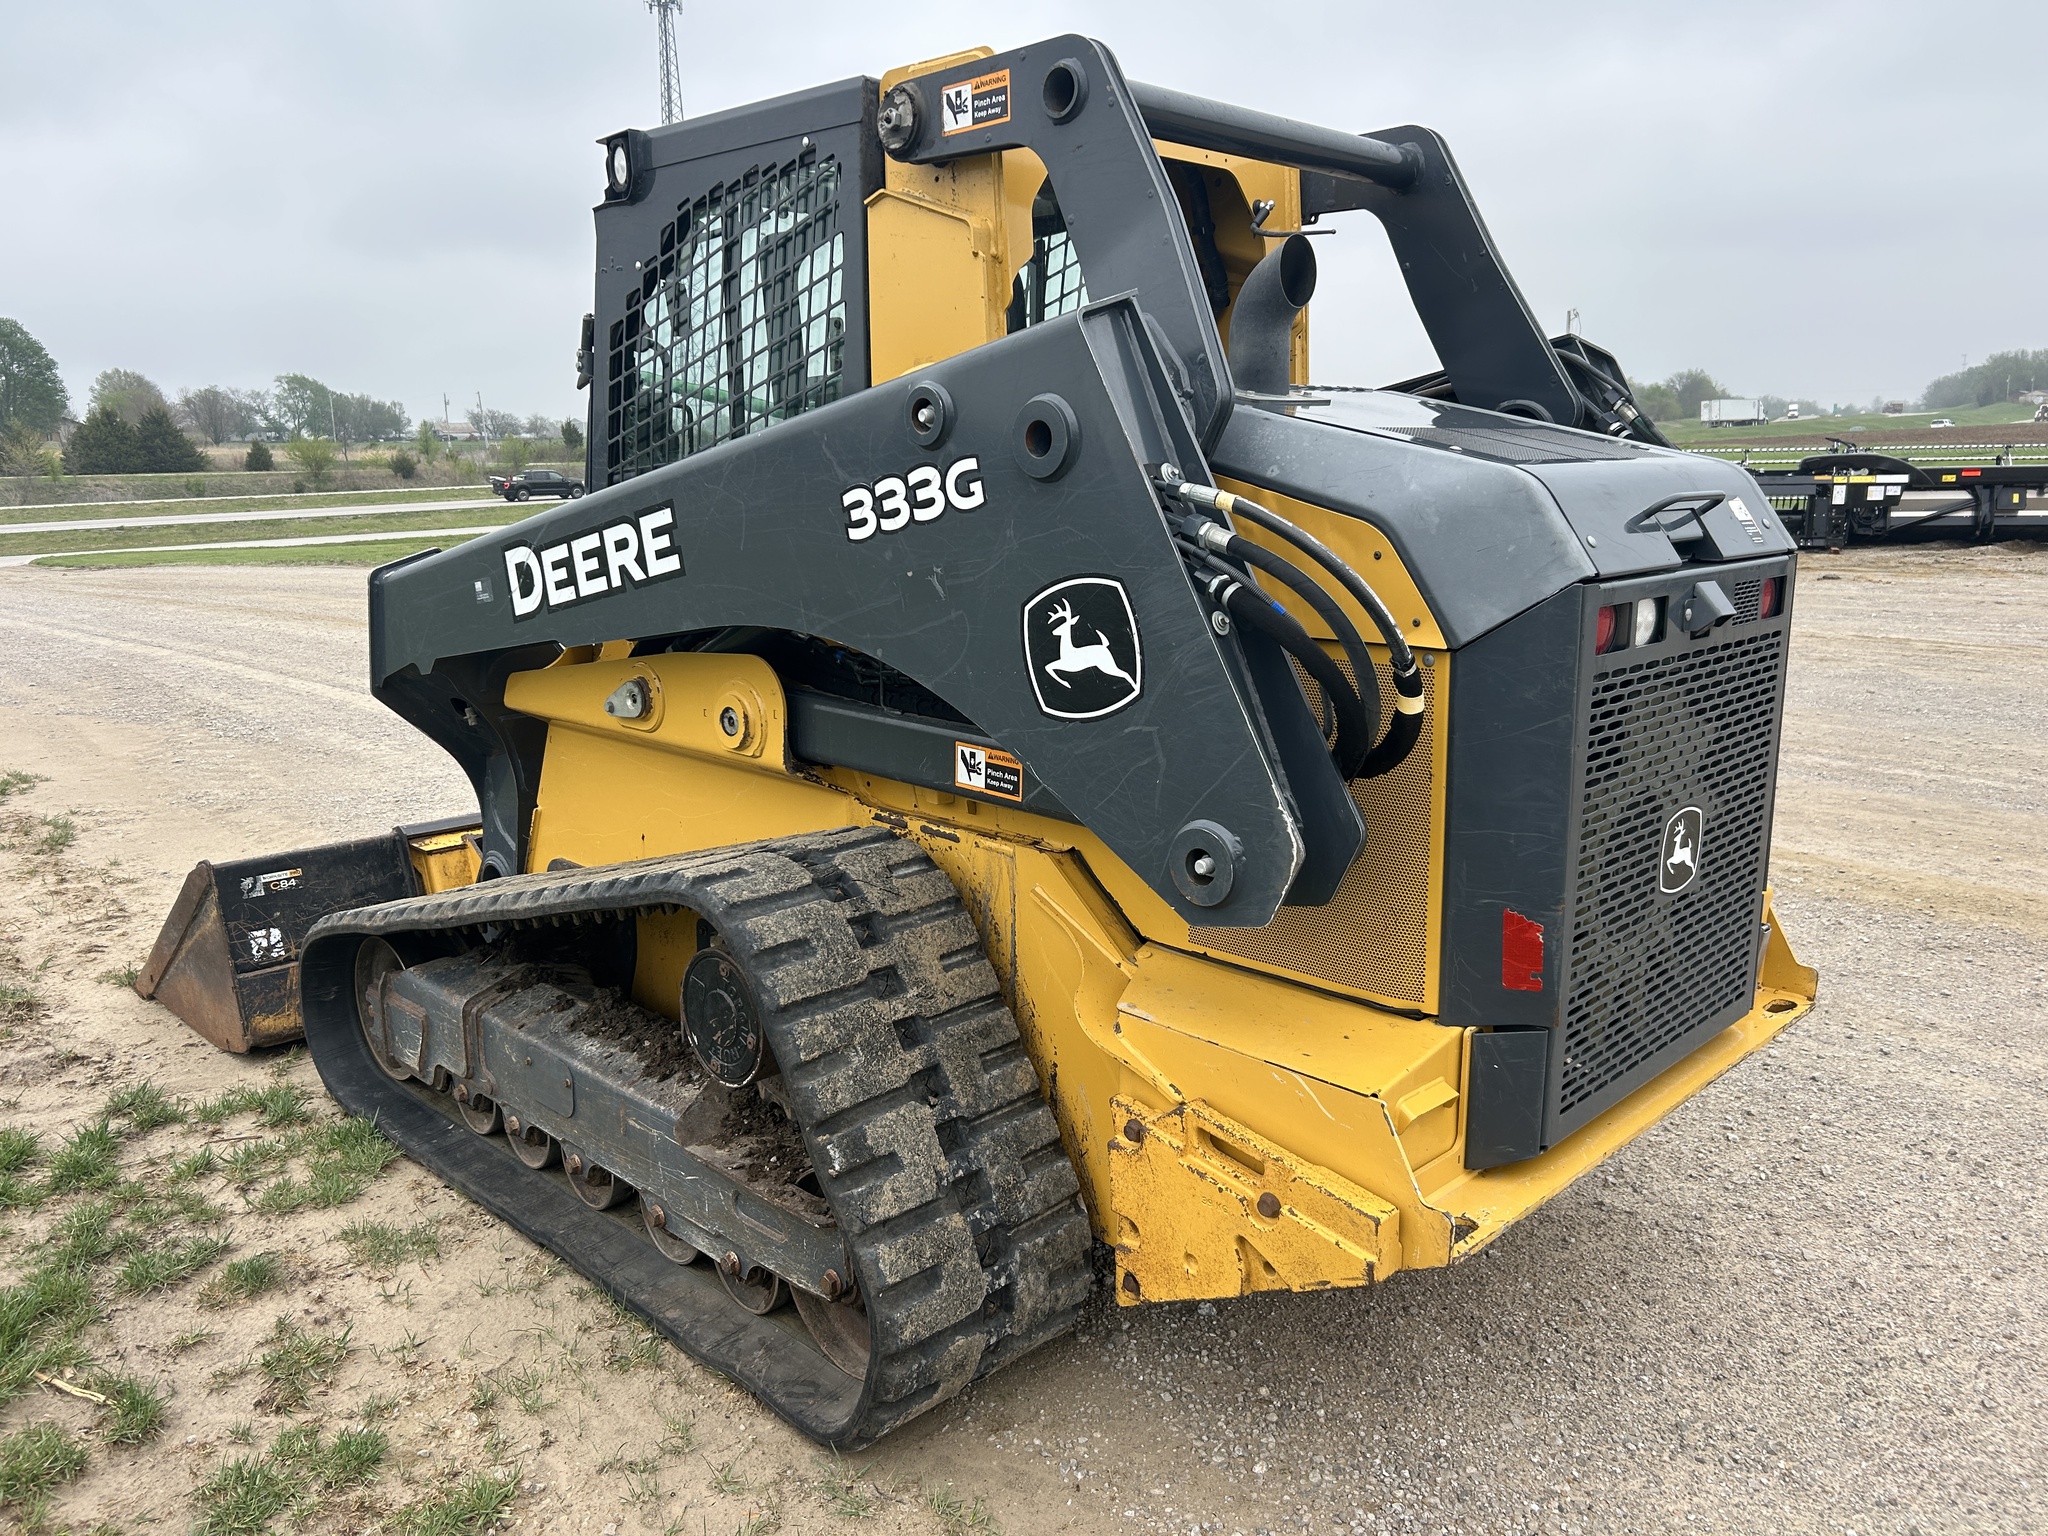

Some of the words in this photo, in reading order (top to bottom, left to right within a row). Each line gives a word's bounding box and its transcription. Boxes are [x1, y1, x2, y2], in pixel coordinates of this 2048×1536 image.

[980, 74, 1007, 88] WARNING
[974, 97, 991, 109] Pinch
[991, 94, 1006, 104] Area
[974, 110, 987, 119] Keep
[987, 106, 1002, 116] Away
[842, 457, 985, 541] 333G
[504, 507, 681, 617] DEERE
[993, 753, 1020, 766] WARNING
[987, 768, 1003, 779] Pinch
[1004, 773, 1018, 782] Area
[987, 778, 1000, 788] Keep
[1000, 781, 1014, 791] Away
[270, 878, 297, 890] C84
